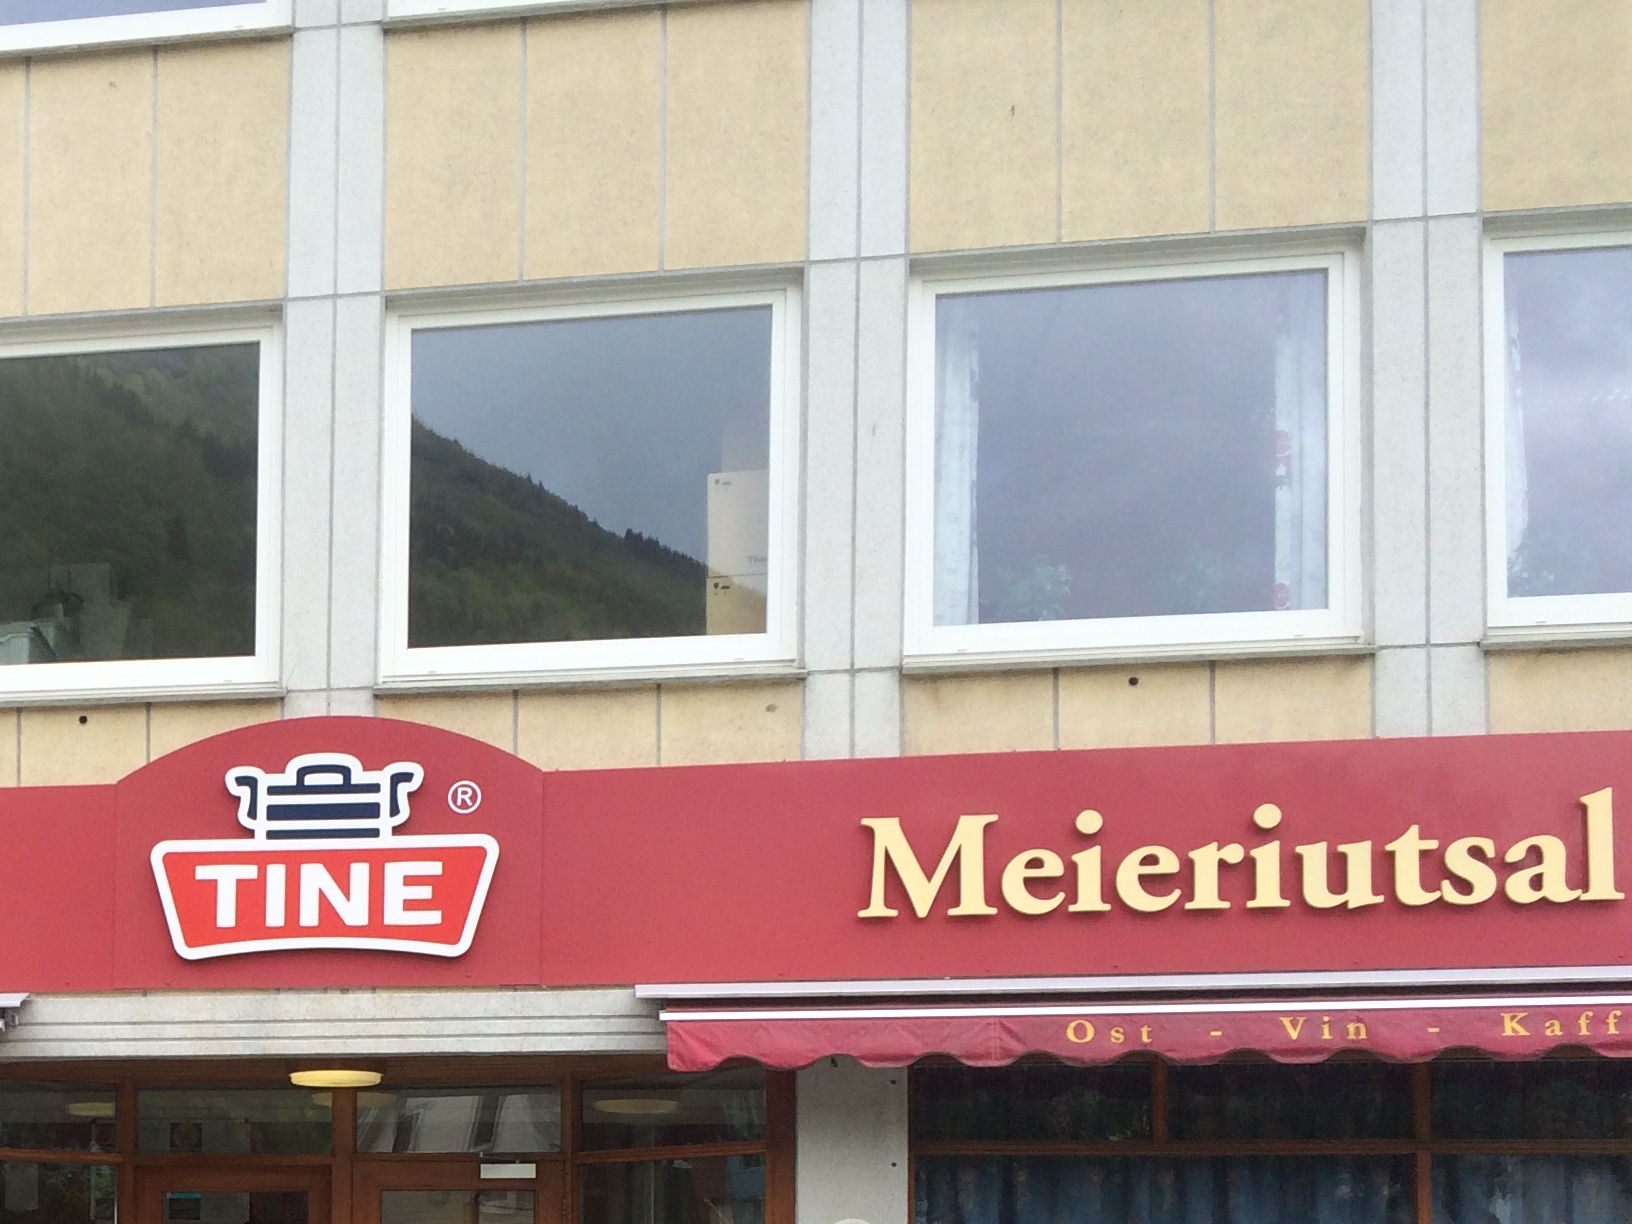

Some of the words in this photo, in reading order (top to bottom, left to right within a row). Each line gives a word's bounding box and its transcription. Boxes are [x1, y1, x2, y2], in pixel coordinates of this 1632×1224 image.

[857, 786, 1626, 919] Meieriutsal
[194, 860, 444, 928] TINE
[1066, 1019, 1153, 1044] Ost
[1279, 1015, 1368, 1041] Vin
